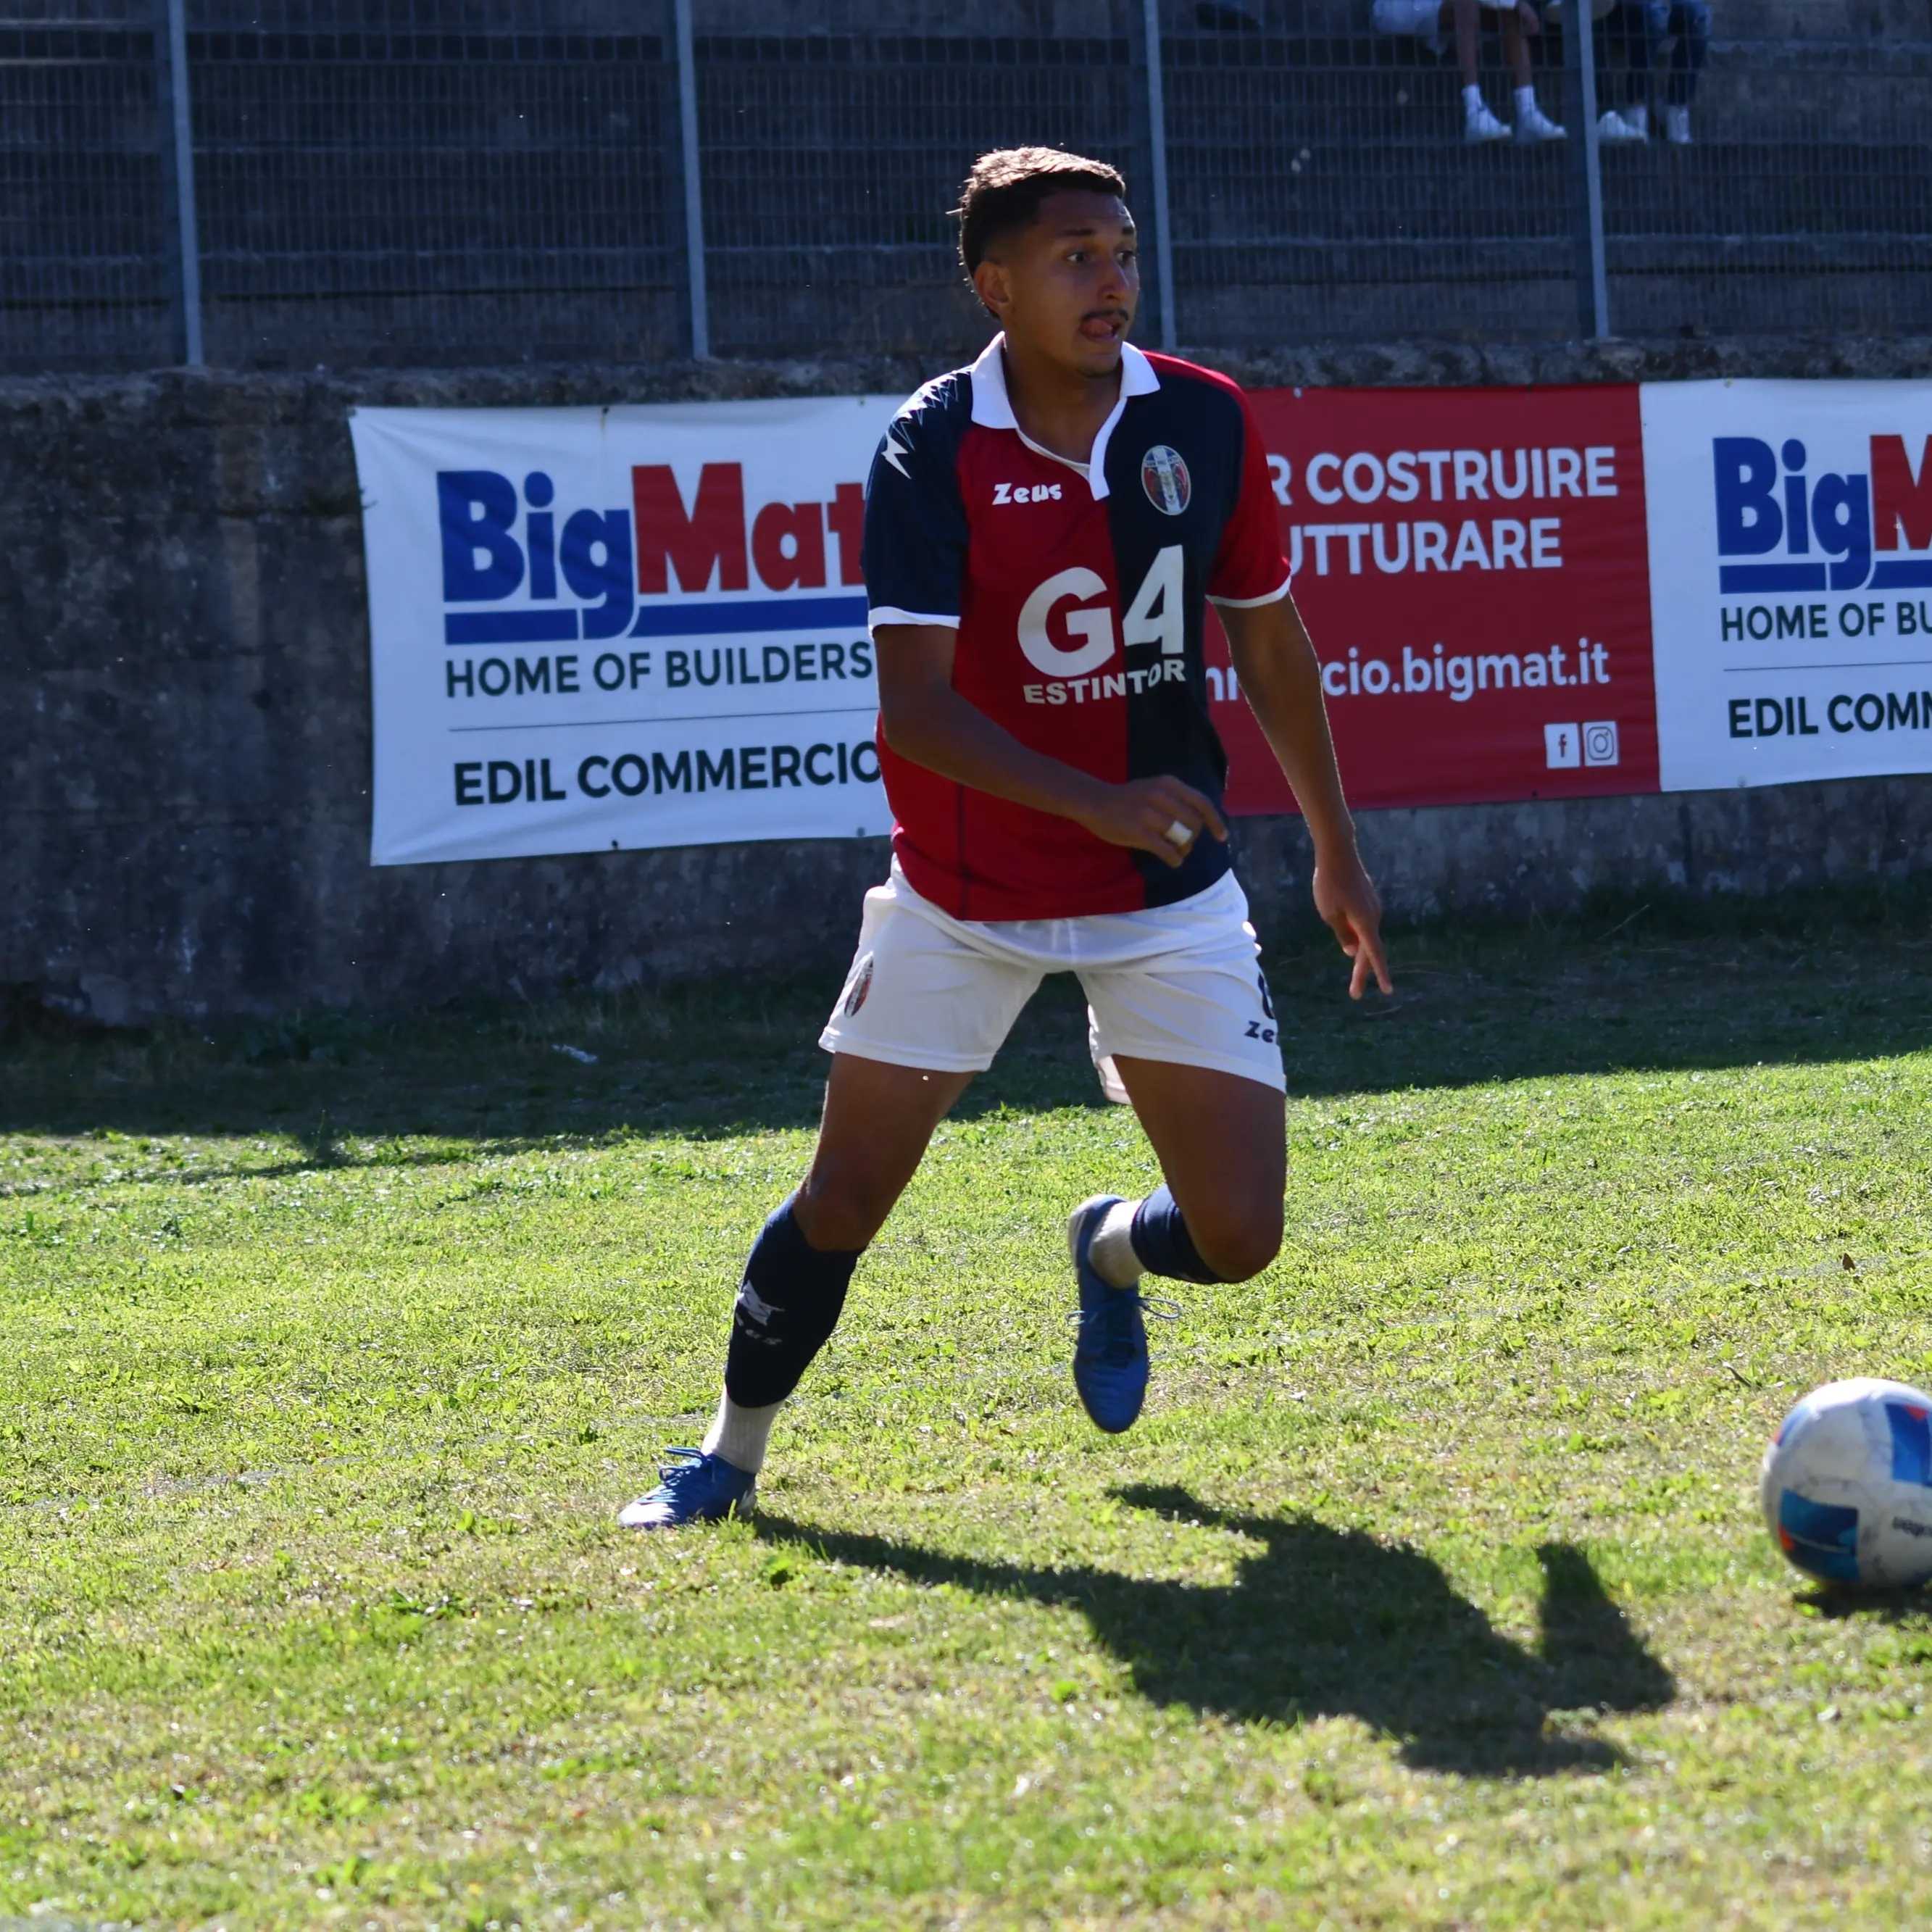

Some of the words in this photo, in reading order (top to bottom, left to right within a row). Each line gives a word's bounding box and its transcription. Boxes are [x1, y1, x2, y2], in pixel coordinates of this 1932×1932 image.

[992, 482, 1062, 505] Zeus
[1267, 454, 1293, 505] R
[1306, 446, 1619, 505] COSTRUIRE
[438, 462, 867, 639] BigMat
[1017, 544, 1184, 677] G4
[1720, 604, 1828, 642] HOME
[1838, 601, 1885, 638] OF
[445, 654, 580, 698] HOME
[593, 651, 651, 692] OF
[666, 641, 873, 688] BUILDERS
[1023, 659, 1186, 705] ESTINTOR
[1728, 696, 1819, 739] EDIL
[454, 758, 567, 806] EDIL
[577, 740, 880, 799] COMMERCIO
[1244, 1020, 1275, 1044] Ze
